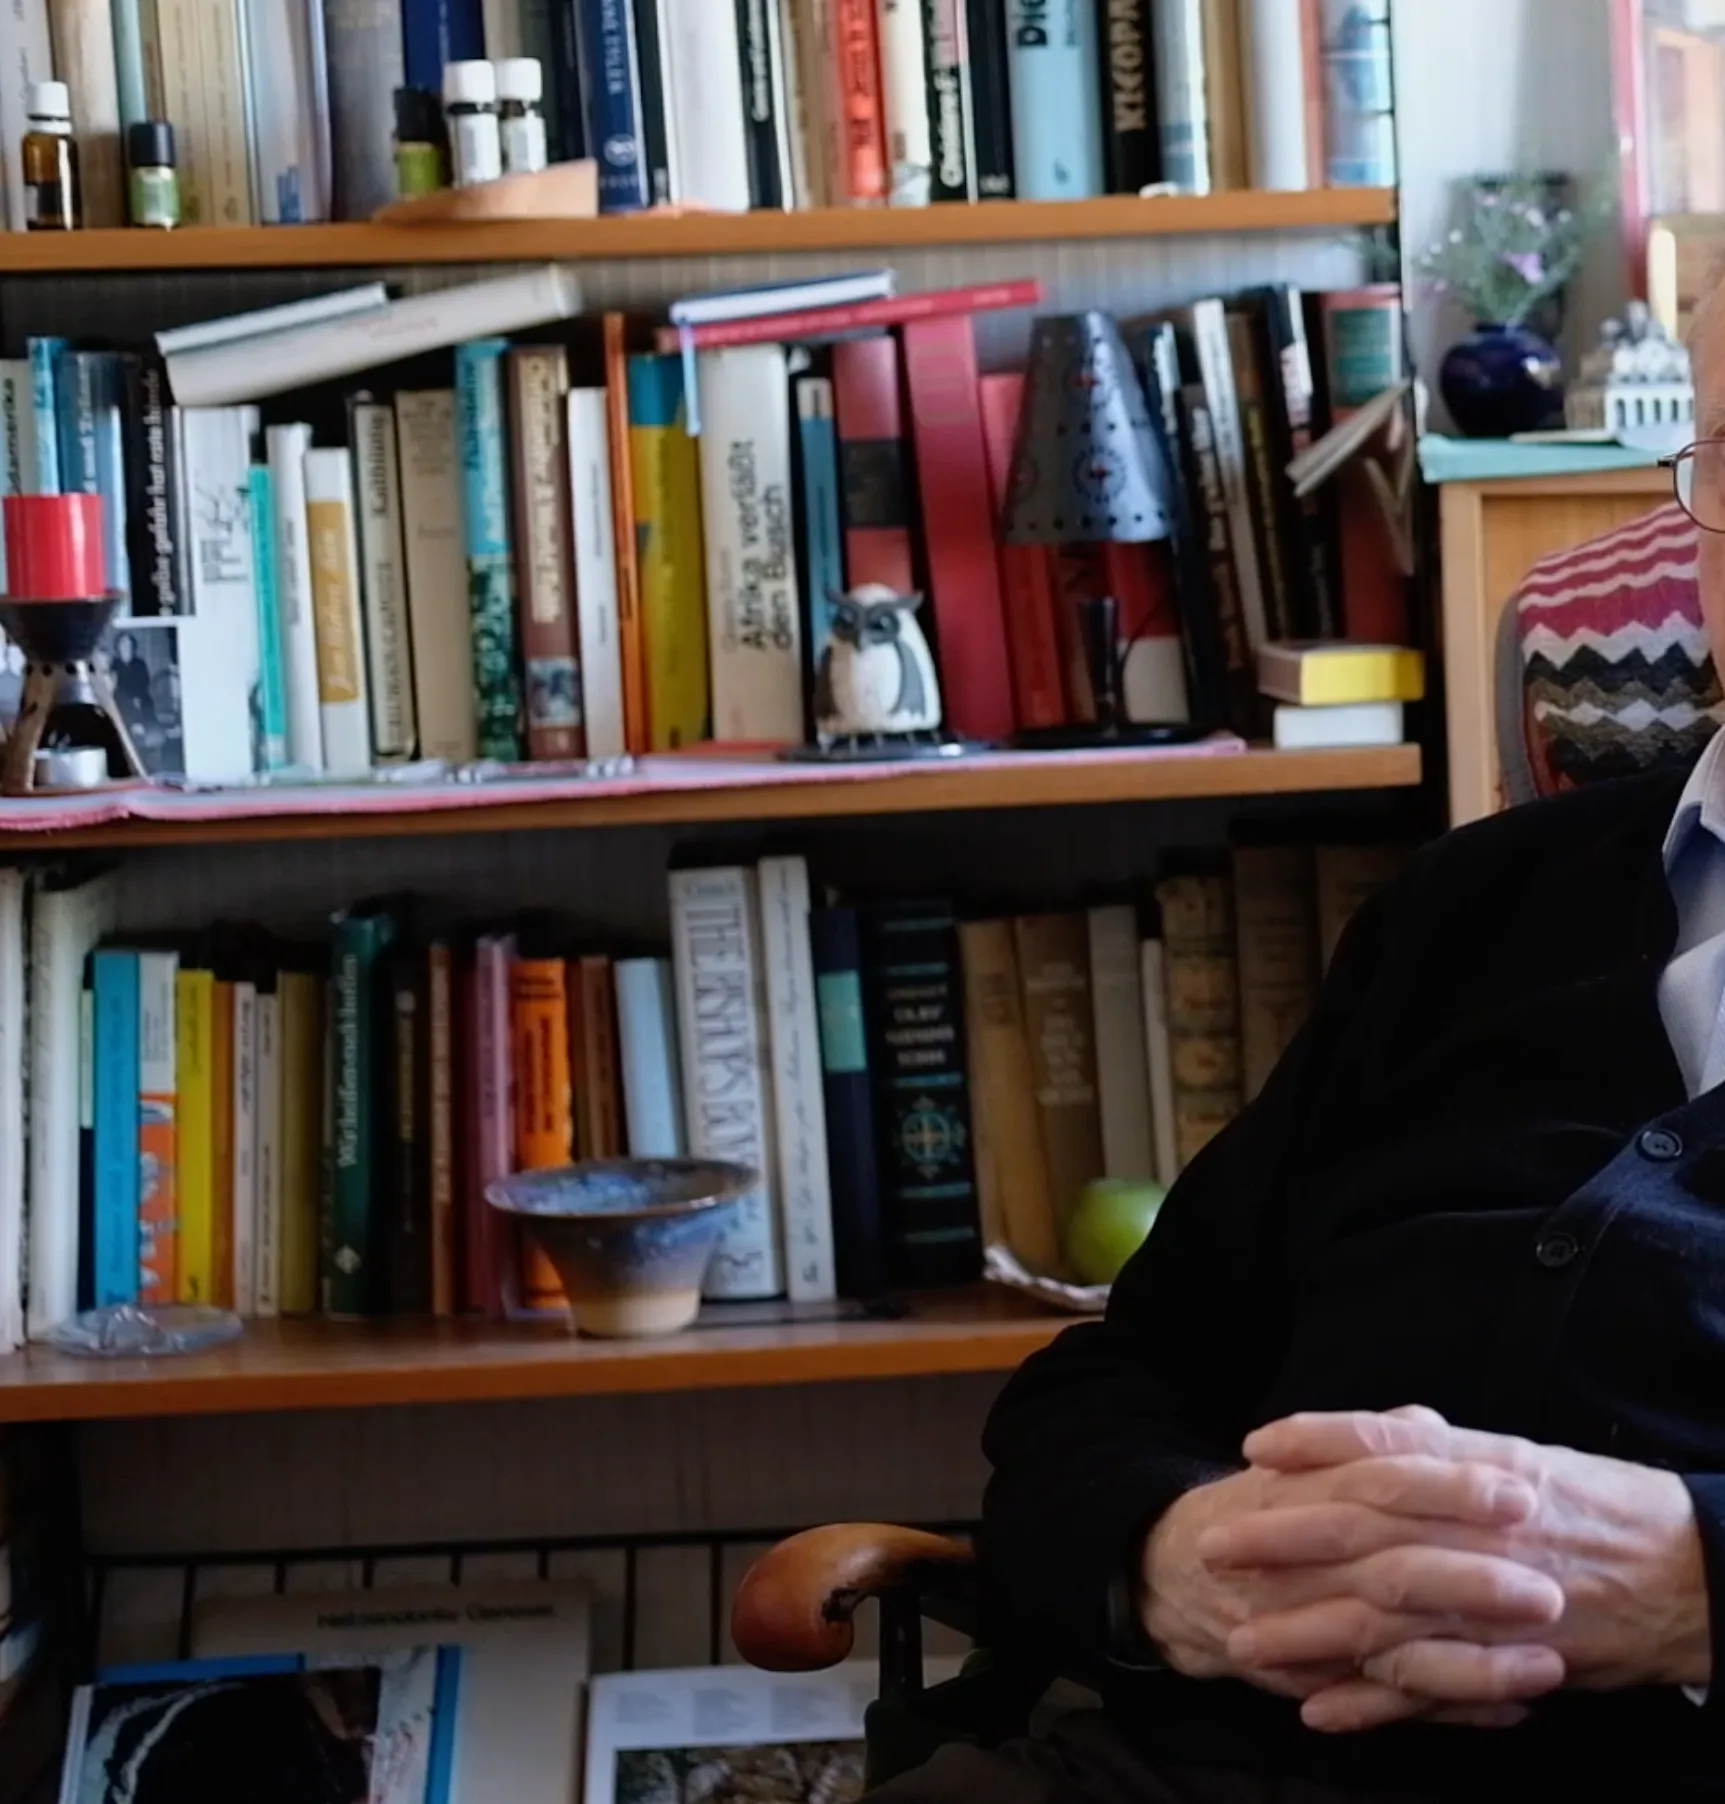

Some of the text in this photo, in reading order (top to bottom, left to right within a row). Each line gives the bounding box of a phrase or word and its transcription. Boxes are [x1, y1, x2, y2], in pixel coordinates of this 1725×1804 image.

[737, 559, 766, 650] Afrika
[761, 485, 790, 650] den Busch
